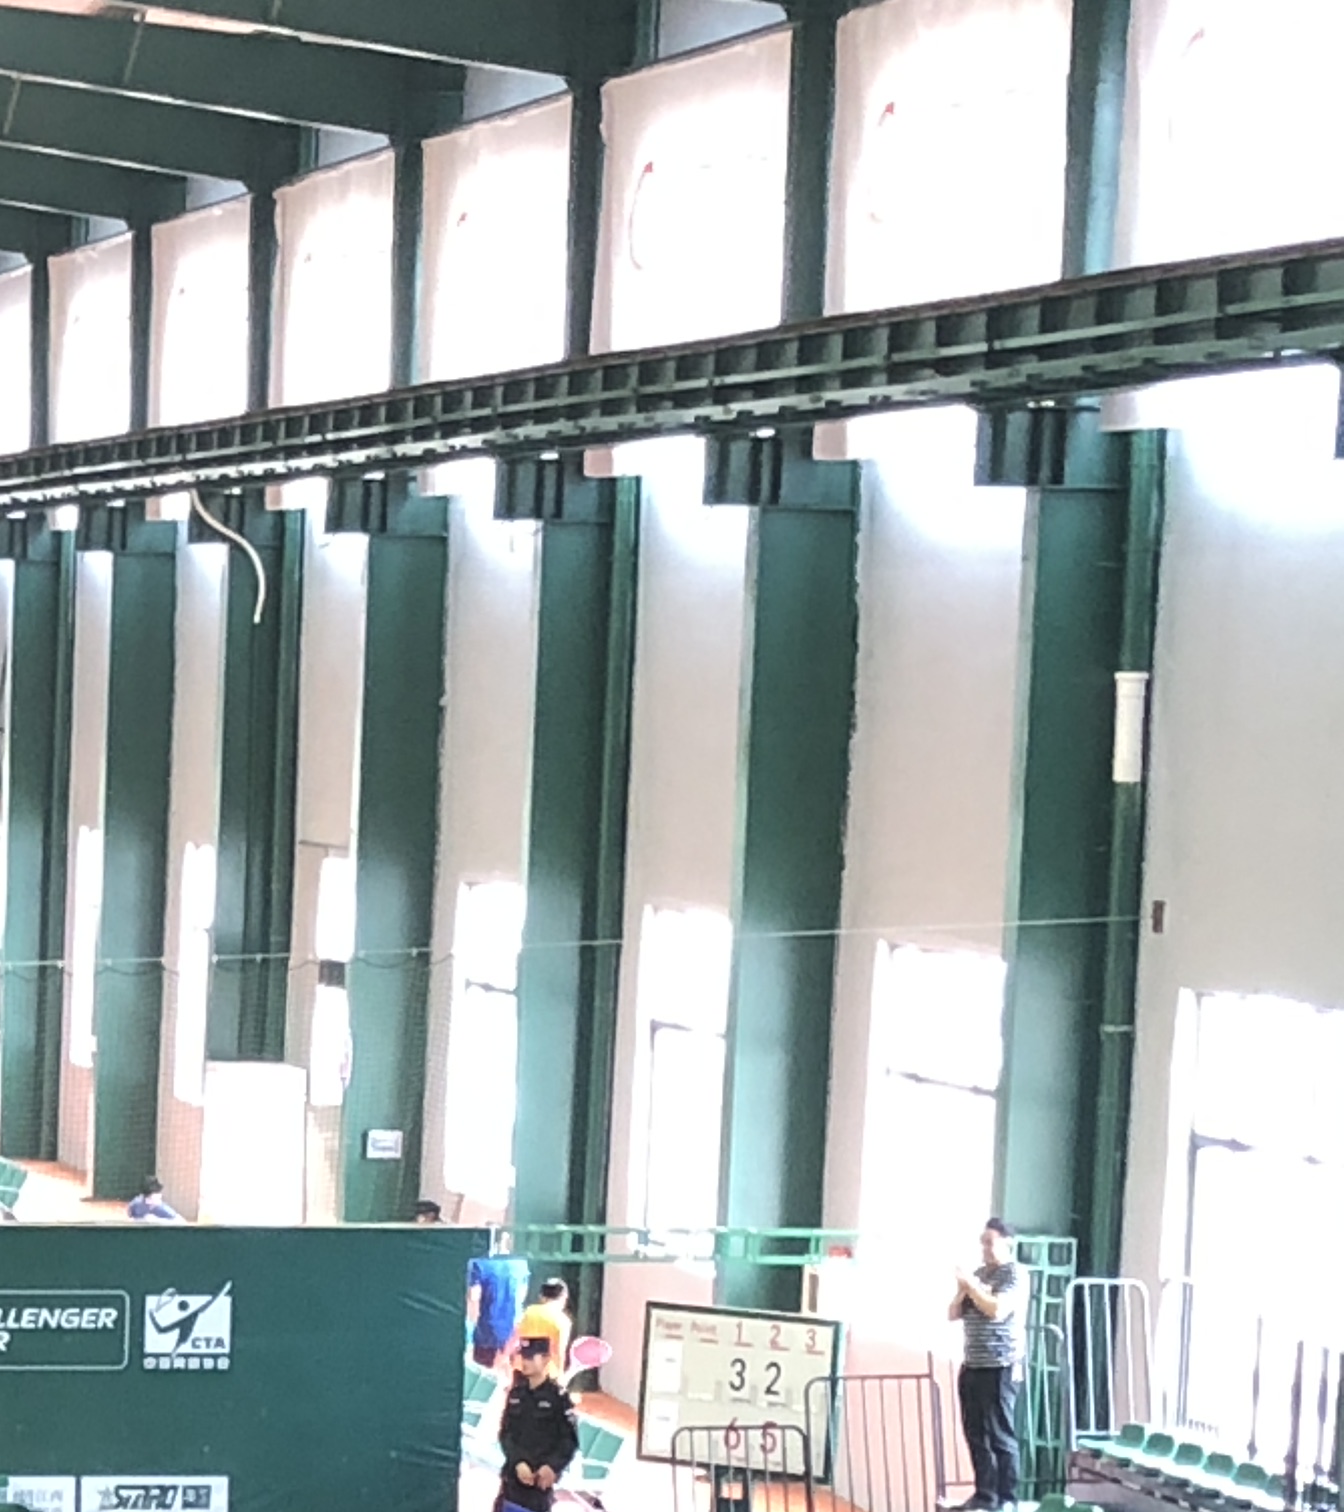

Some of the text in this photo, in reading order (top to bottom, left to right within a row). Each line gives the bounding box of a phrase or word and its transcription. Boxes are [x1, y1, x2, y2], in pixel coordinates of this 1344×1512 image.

[190, 1335, 227, 1350] CTA
[735, 1320, 745, 1344] 1
[768, 1323, 783, 1349] 2
[804, 1327, 818, 1352] 3
[728, 1357, 782, 1396] 3 2
[723, 1416, 778, 1454] 6 5
